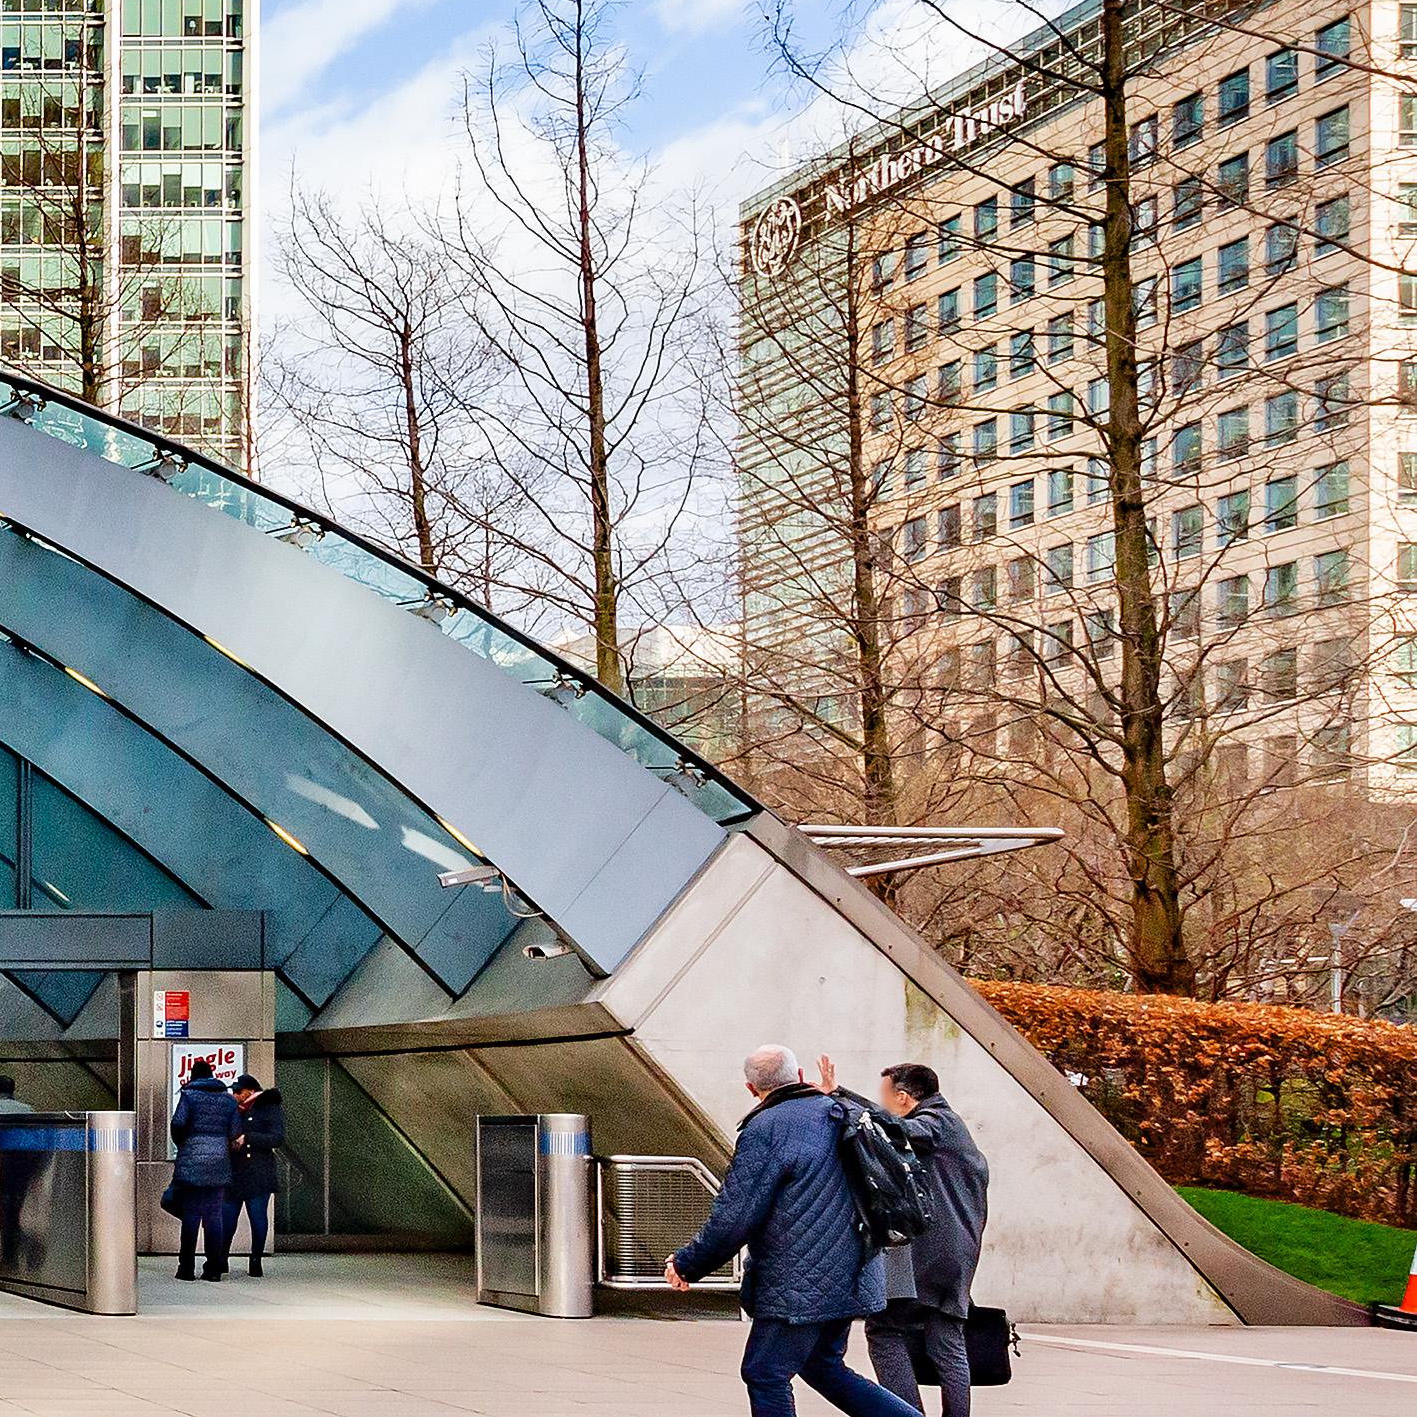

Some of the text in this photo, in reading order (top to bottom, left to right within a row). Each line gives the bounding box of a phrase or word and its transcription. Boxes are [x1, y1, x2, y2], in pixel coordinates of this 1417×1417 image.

[823, 79, 1027, 221] Northern Trust
[215, 1070, 237, 1079] way
